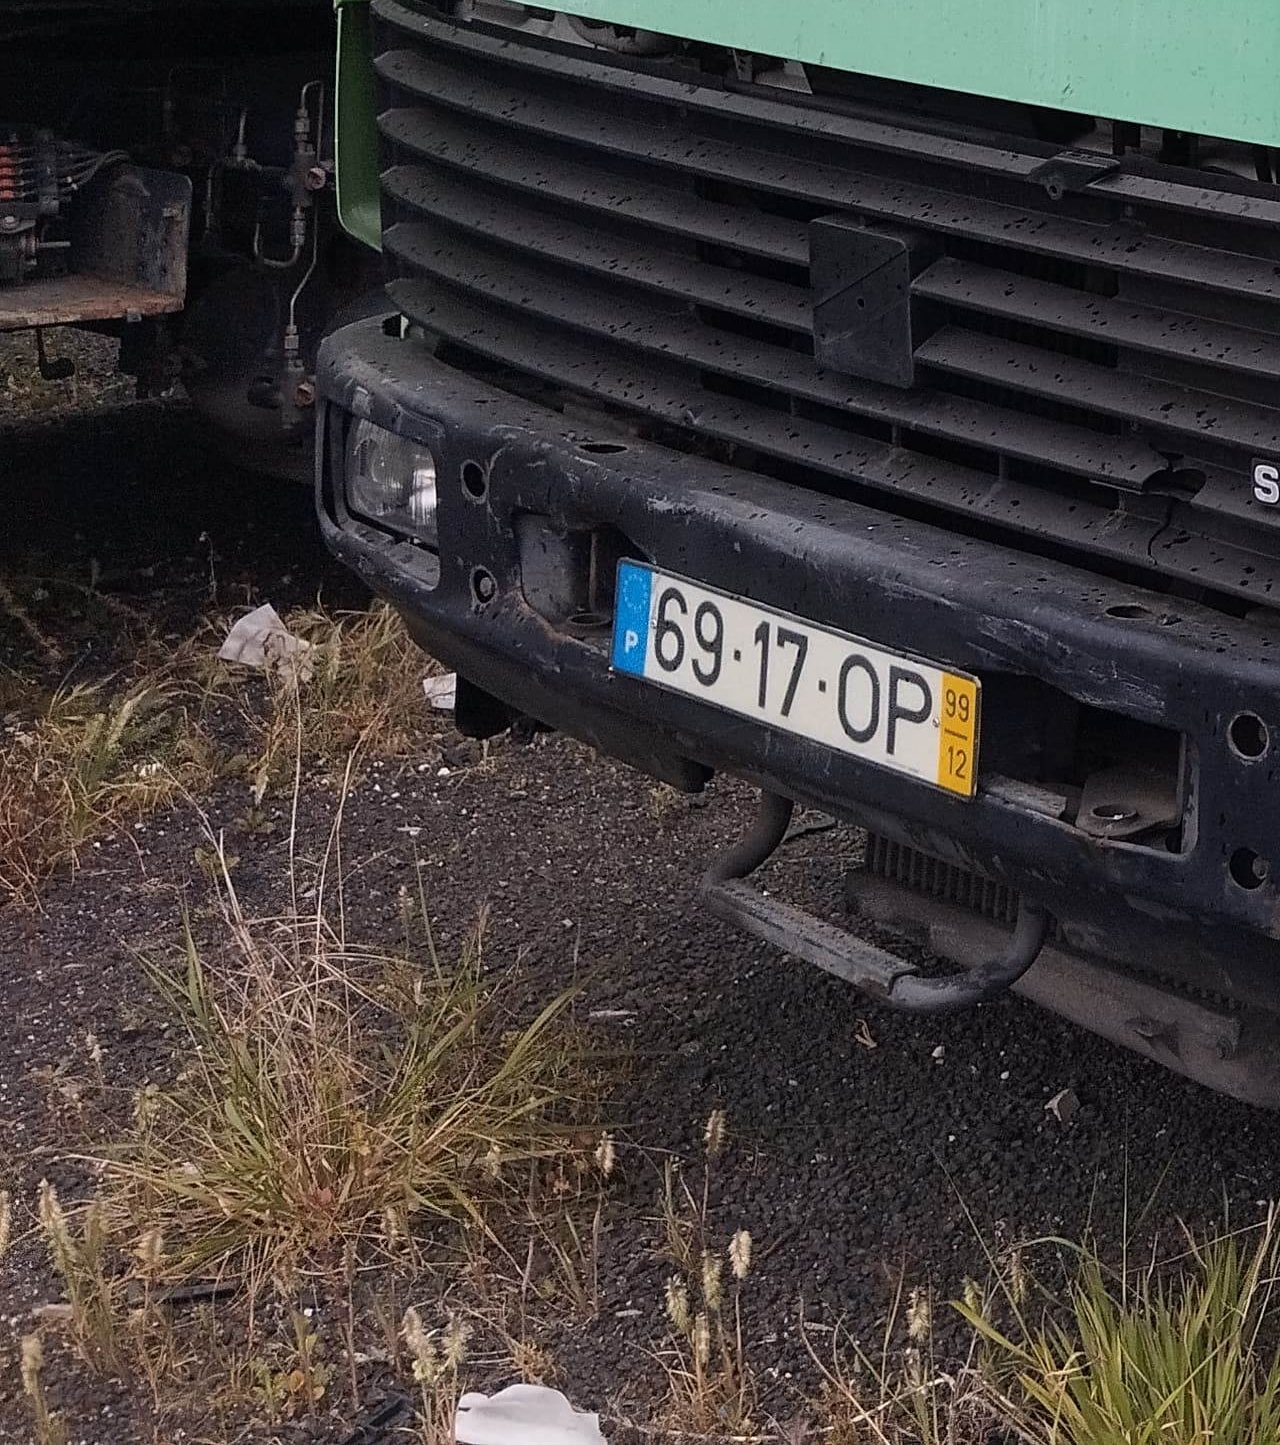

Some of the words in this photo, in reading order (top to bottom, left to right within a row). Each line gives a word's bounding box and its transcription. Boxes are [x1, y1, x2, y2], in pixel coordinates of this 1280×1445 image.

[624, 629, 639, 653] P
[945, 689, 970, 722] 99
[947, 744, 967, 779] 12
